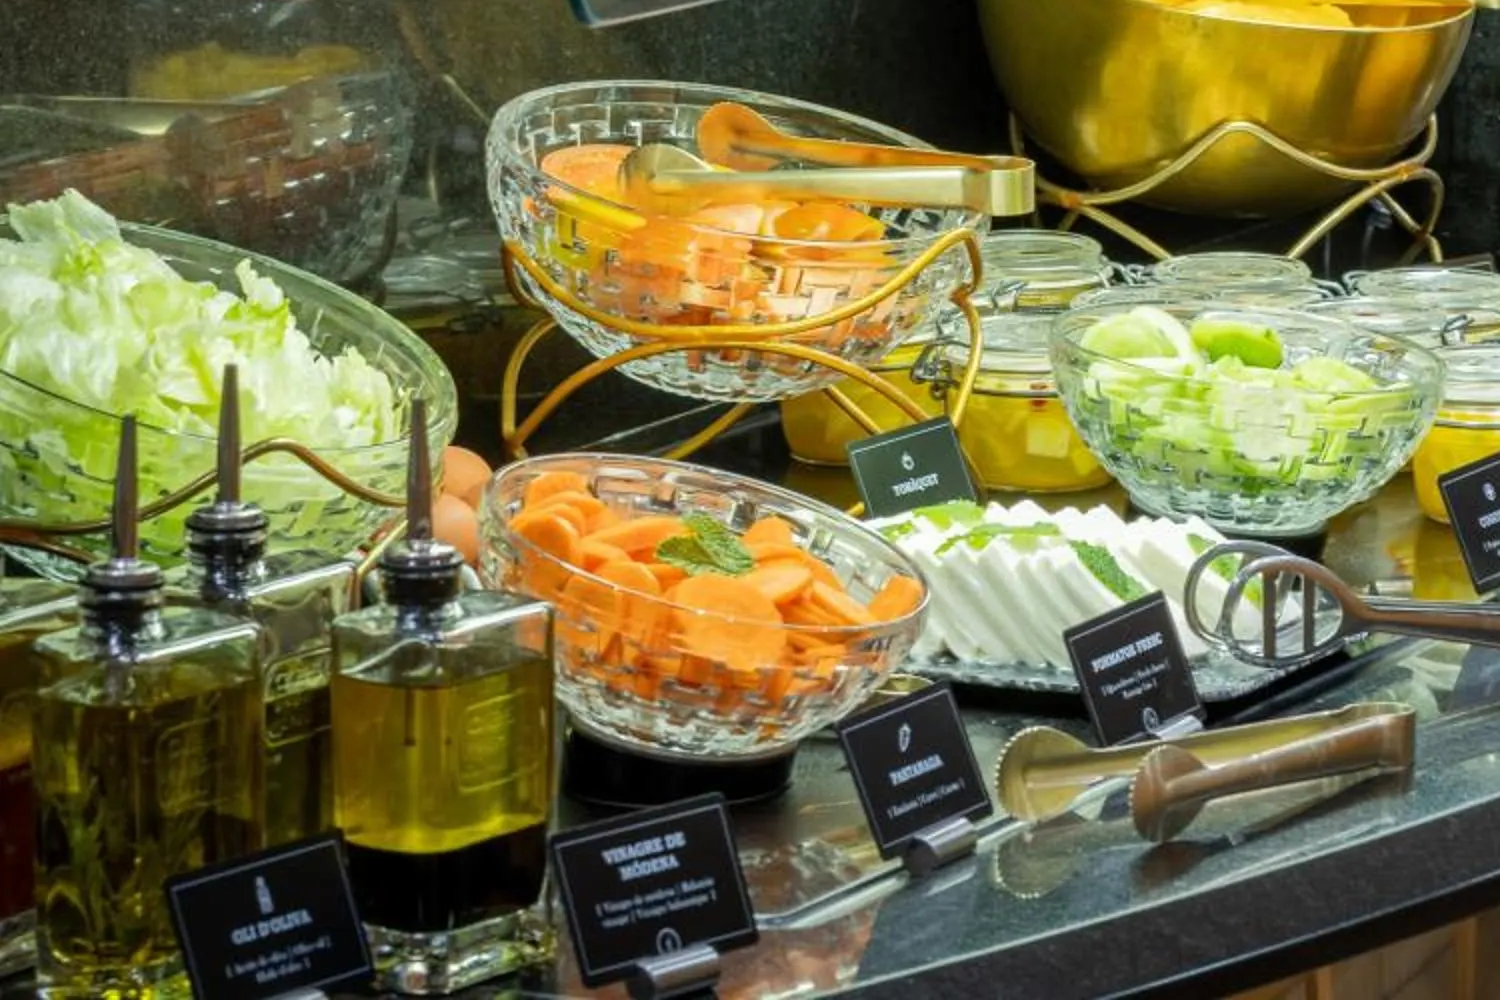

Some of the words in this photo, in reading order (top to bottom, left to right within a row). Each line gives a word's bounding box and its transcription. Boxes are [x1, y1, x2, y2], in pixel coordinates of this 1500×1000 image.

[602, 837, 664, 864] VINAGRE
[664, 831, 687, 850] DE
[231, 925, 257, 945] OLI
[259, 909, 313, 938] D'OLIVA
